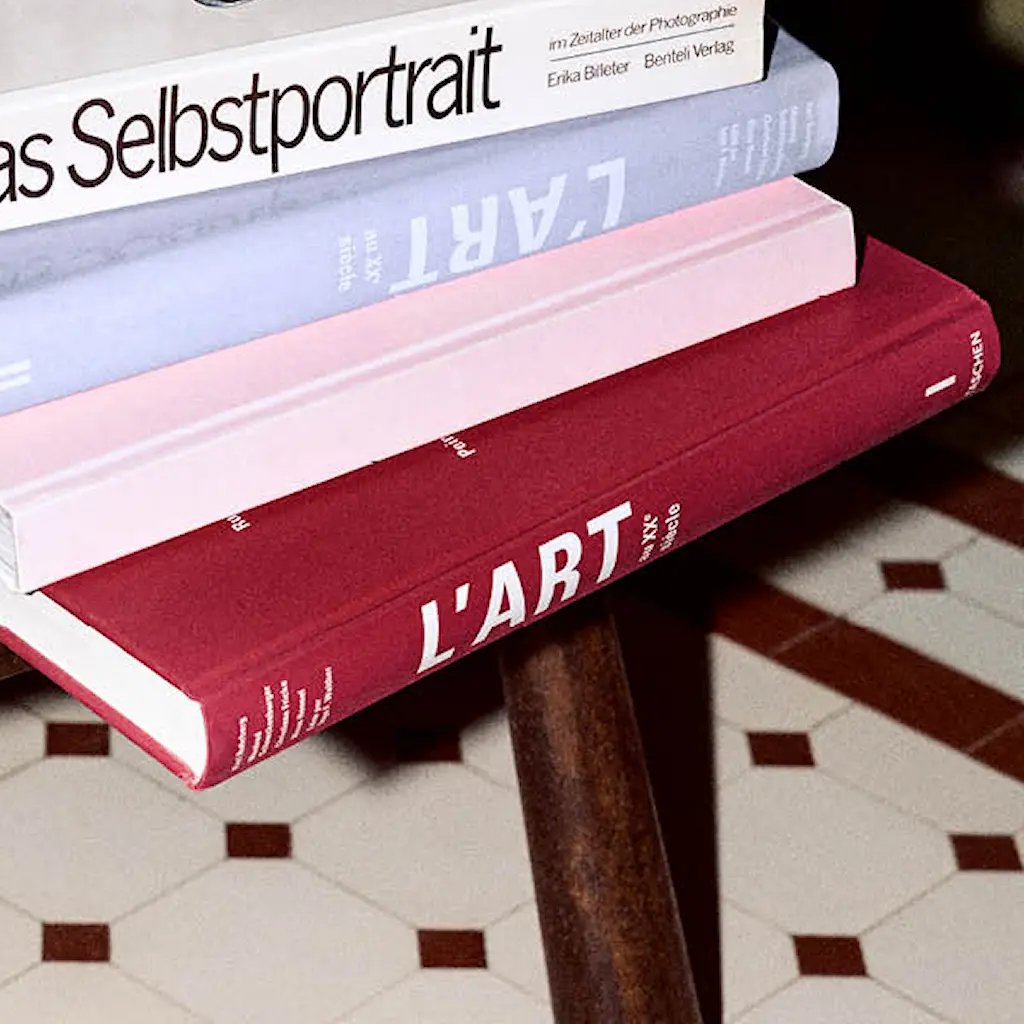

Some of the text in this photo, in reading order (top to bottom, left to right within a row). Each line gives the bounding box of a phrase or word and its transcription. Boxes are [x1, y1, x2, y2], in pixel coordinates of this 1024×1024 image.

[547, 60, 631, 88] Erika Billeter
[549, 4, 738, 52] im Zeitalter der Photographie
[644, 39, 736, 69] Benteli Verlag
[67, 25, 503, 188] Selbstportrait
[388, 157, 627, 295] L'ART
[416, 500, 633, 675] L'ART
